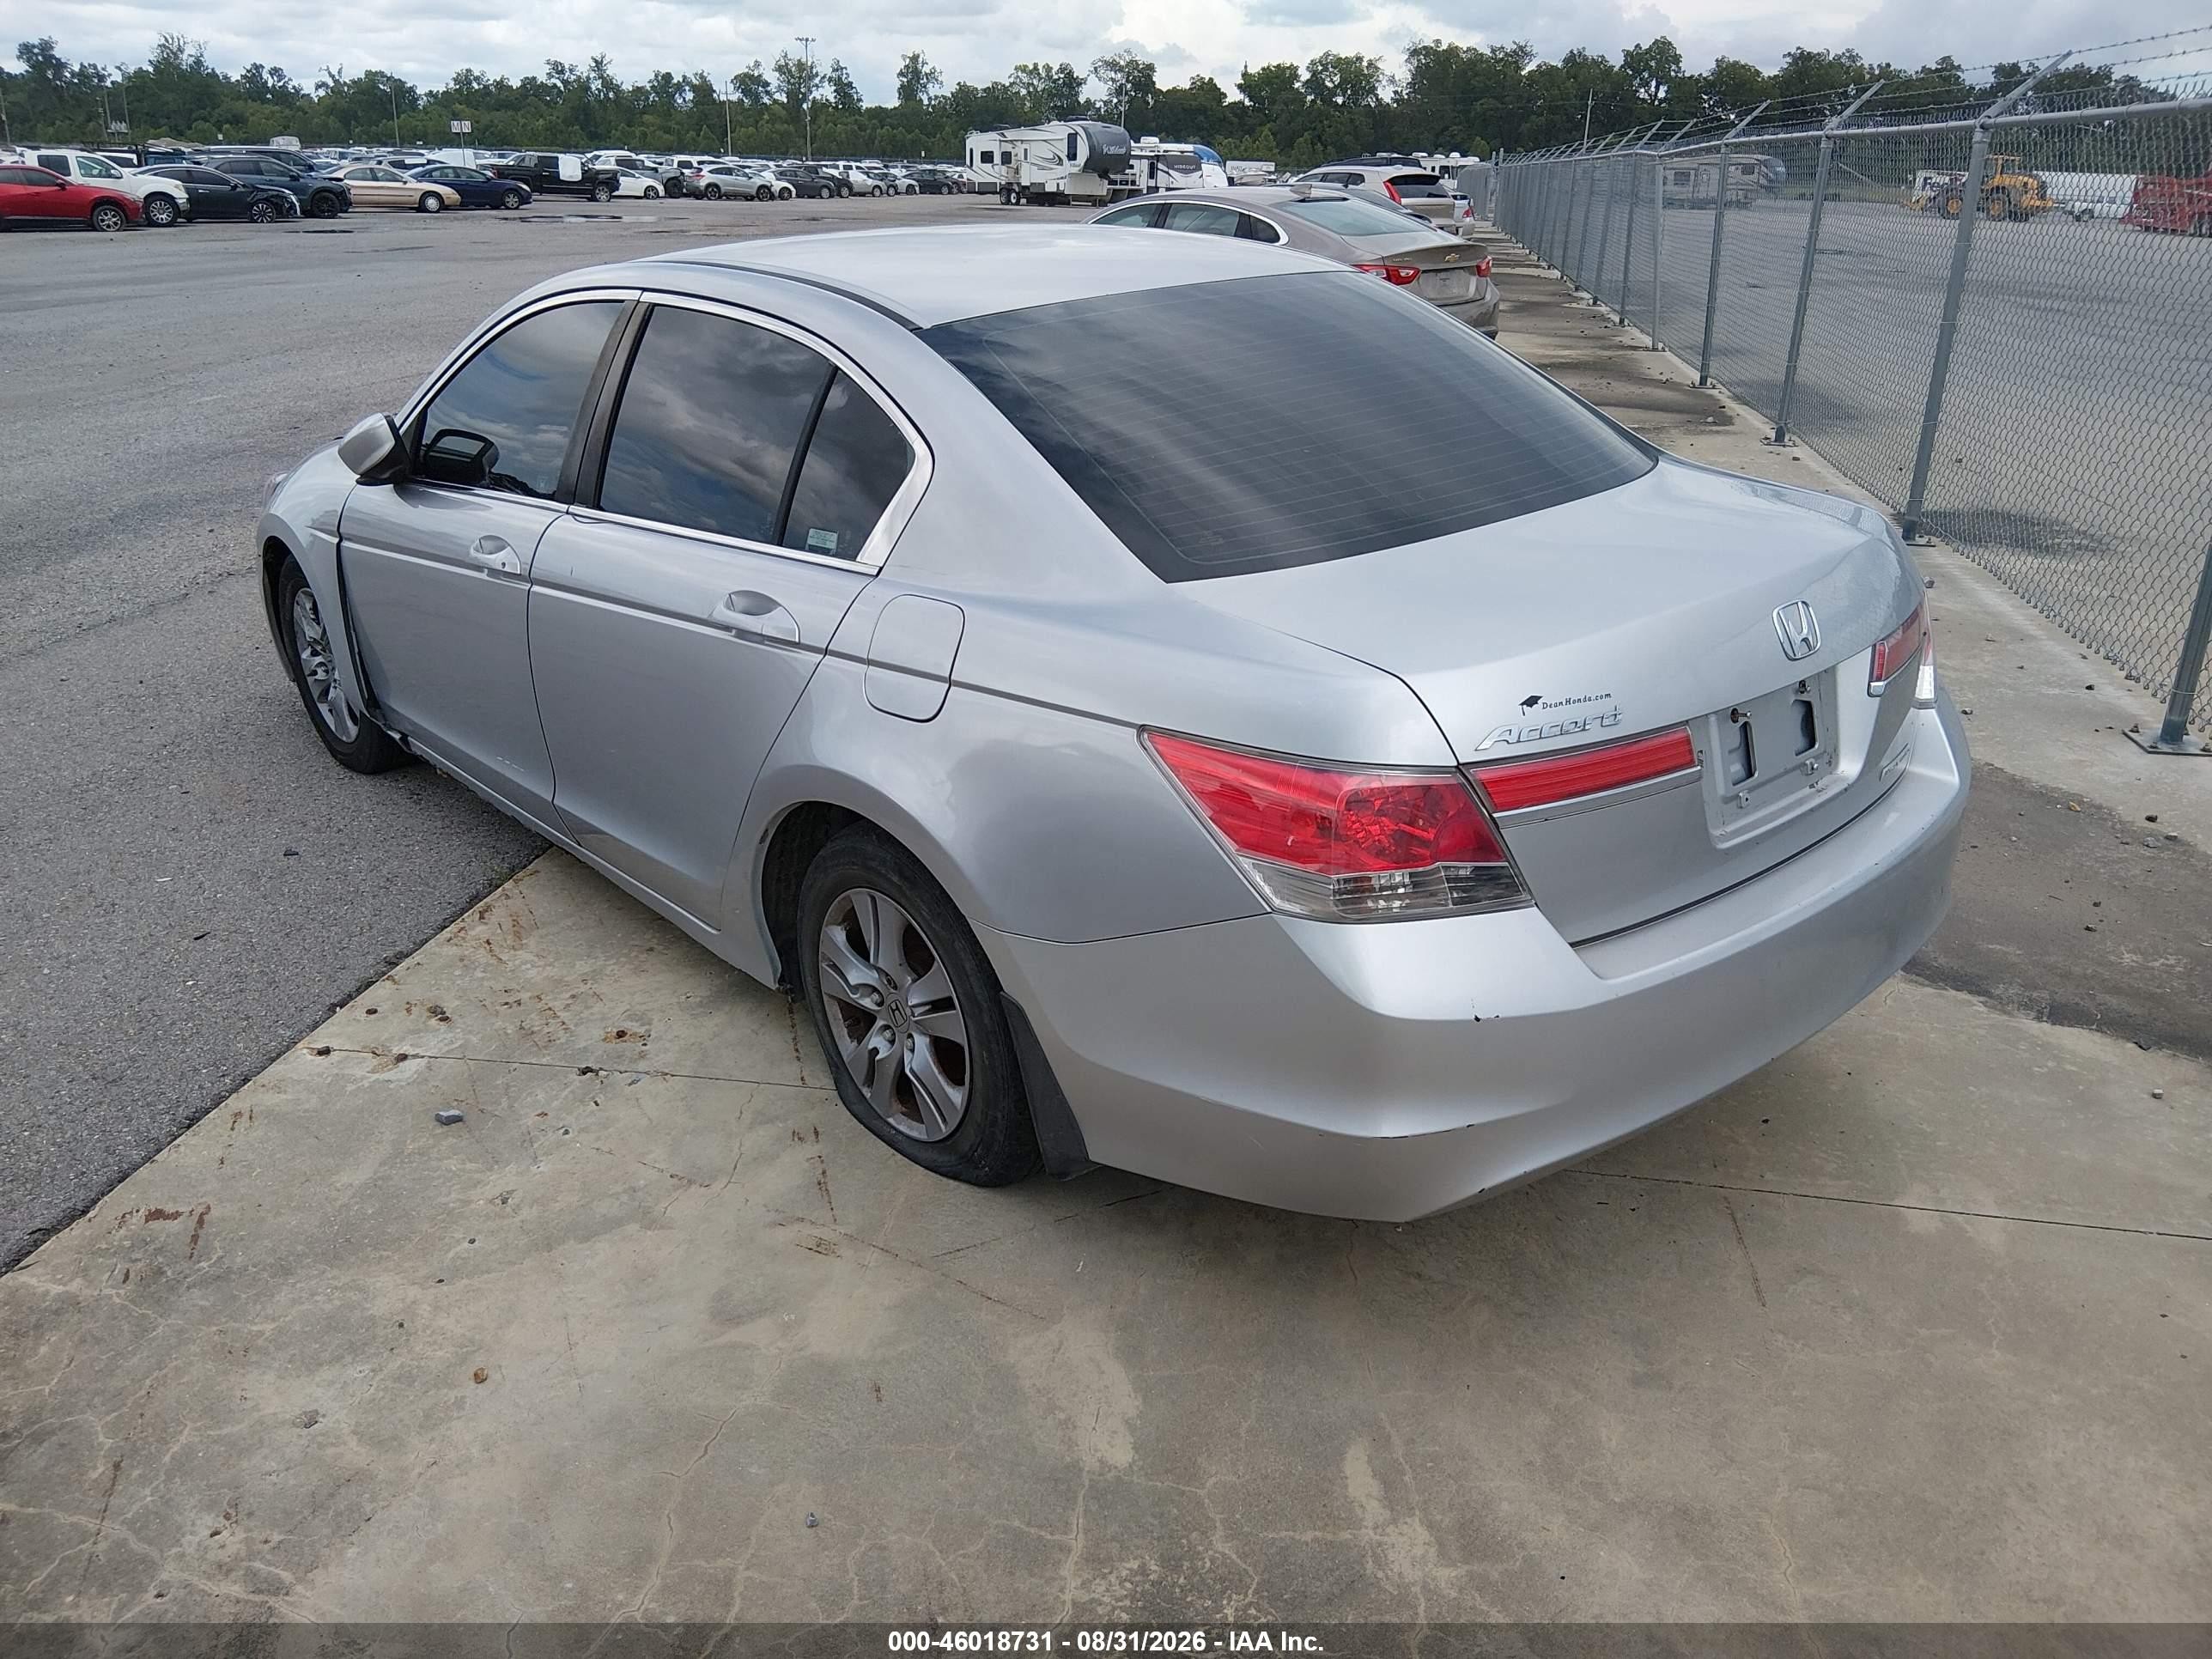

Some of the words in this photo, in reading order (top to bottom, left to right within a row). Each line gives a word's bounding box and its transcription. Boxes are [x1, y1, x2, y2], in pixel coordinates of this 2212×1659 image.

[453, 122, 460, 131] M
[463, 122, 471, 131] N
[1542, 692, 1612, 710] DeanHonda.com
[1474, 705, 1623, 751] Accord
